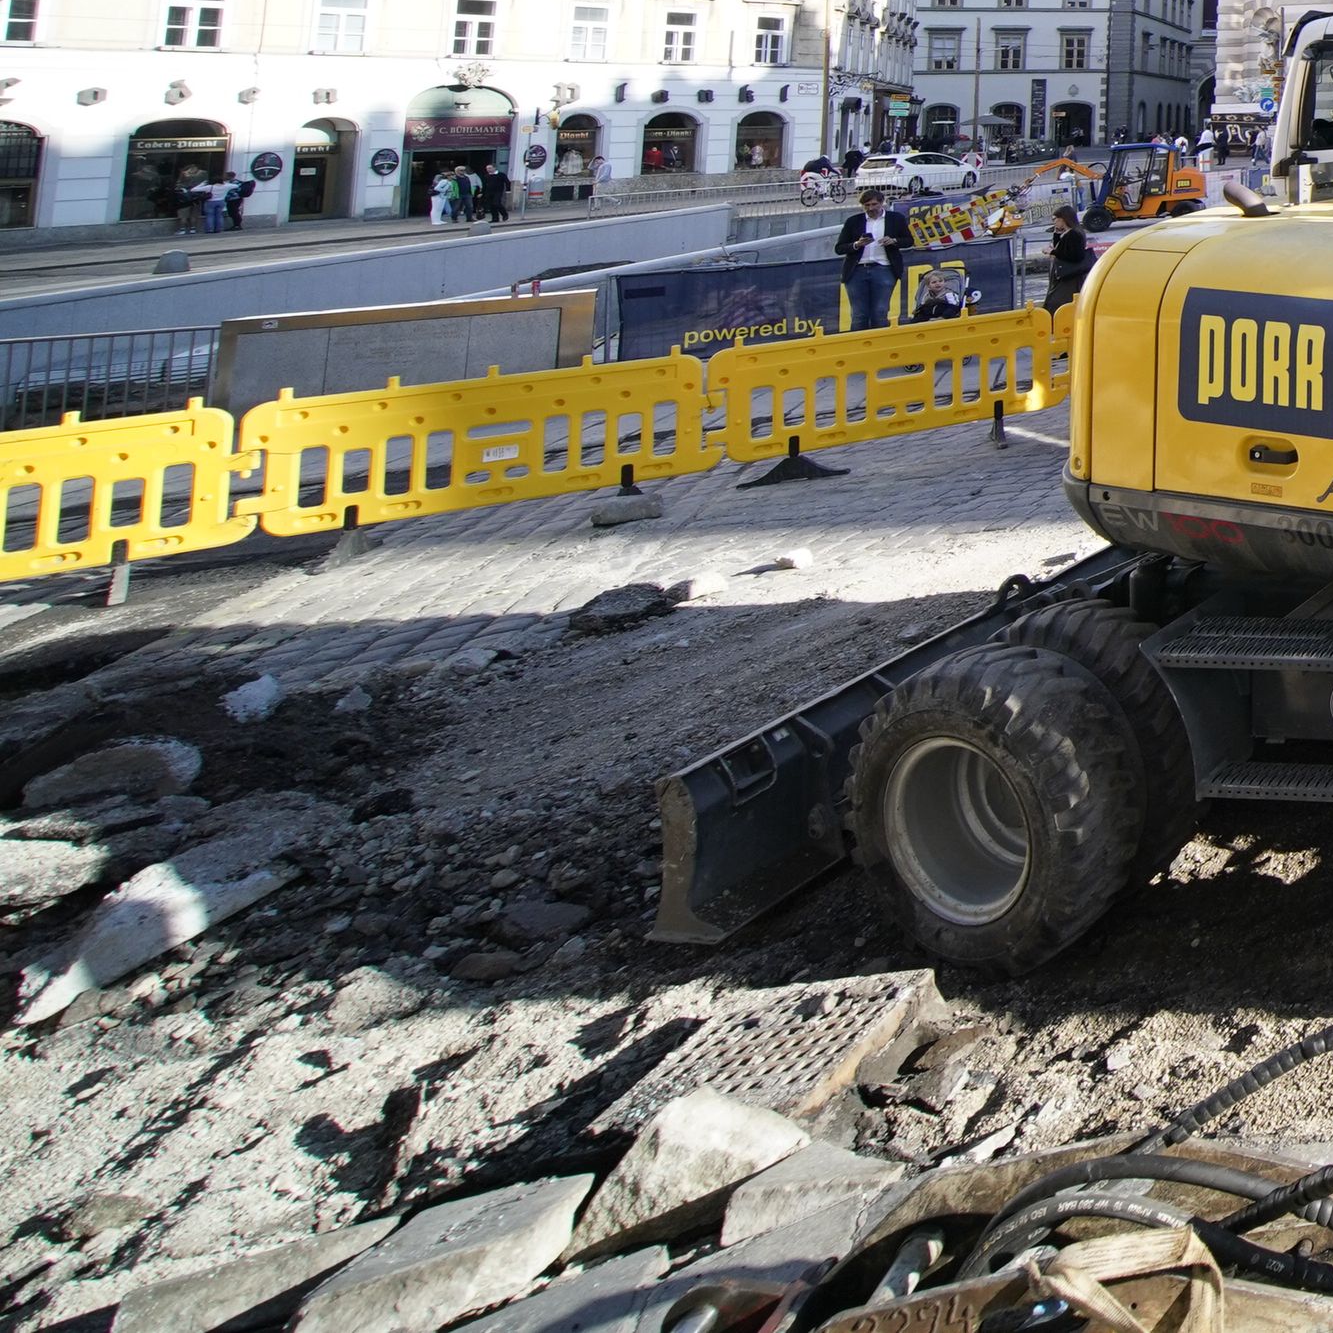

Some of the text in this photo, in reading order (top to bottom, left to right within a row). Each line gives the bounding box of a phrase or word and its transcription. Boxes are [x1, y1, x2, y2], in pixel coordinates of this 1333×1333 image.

[439, 124, 506, 135] C. BÜHLMAYER
[684, 316, 821, 348] powered by
[1197, 314, 1326, 411] PORR
